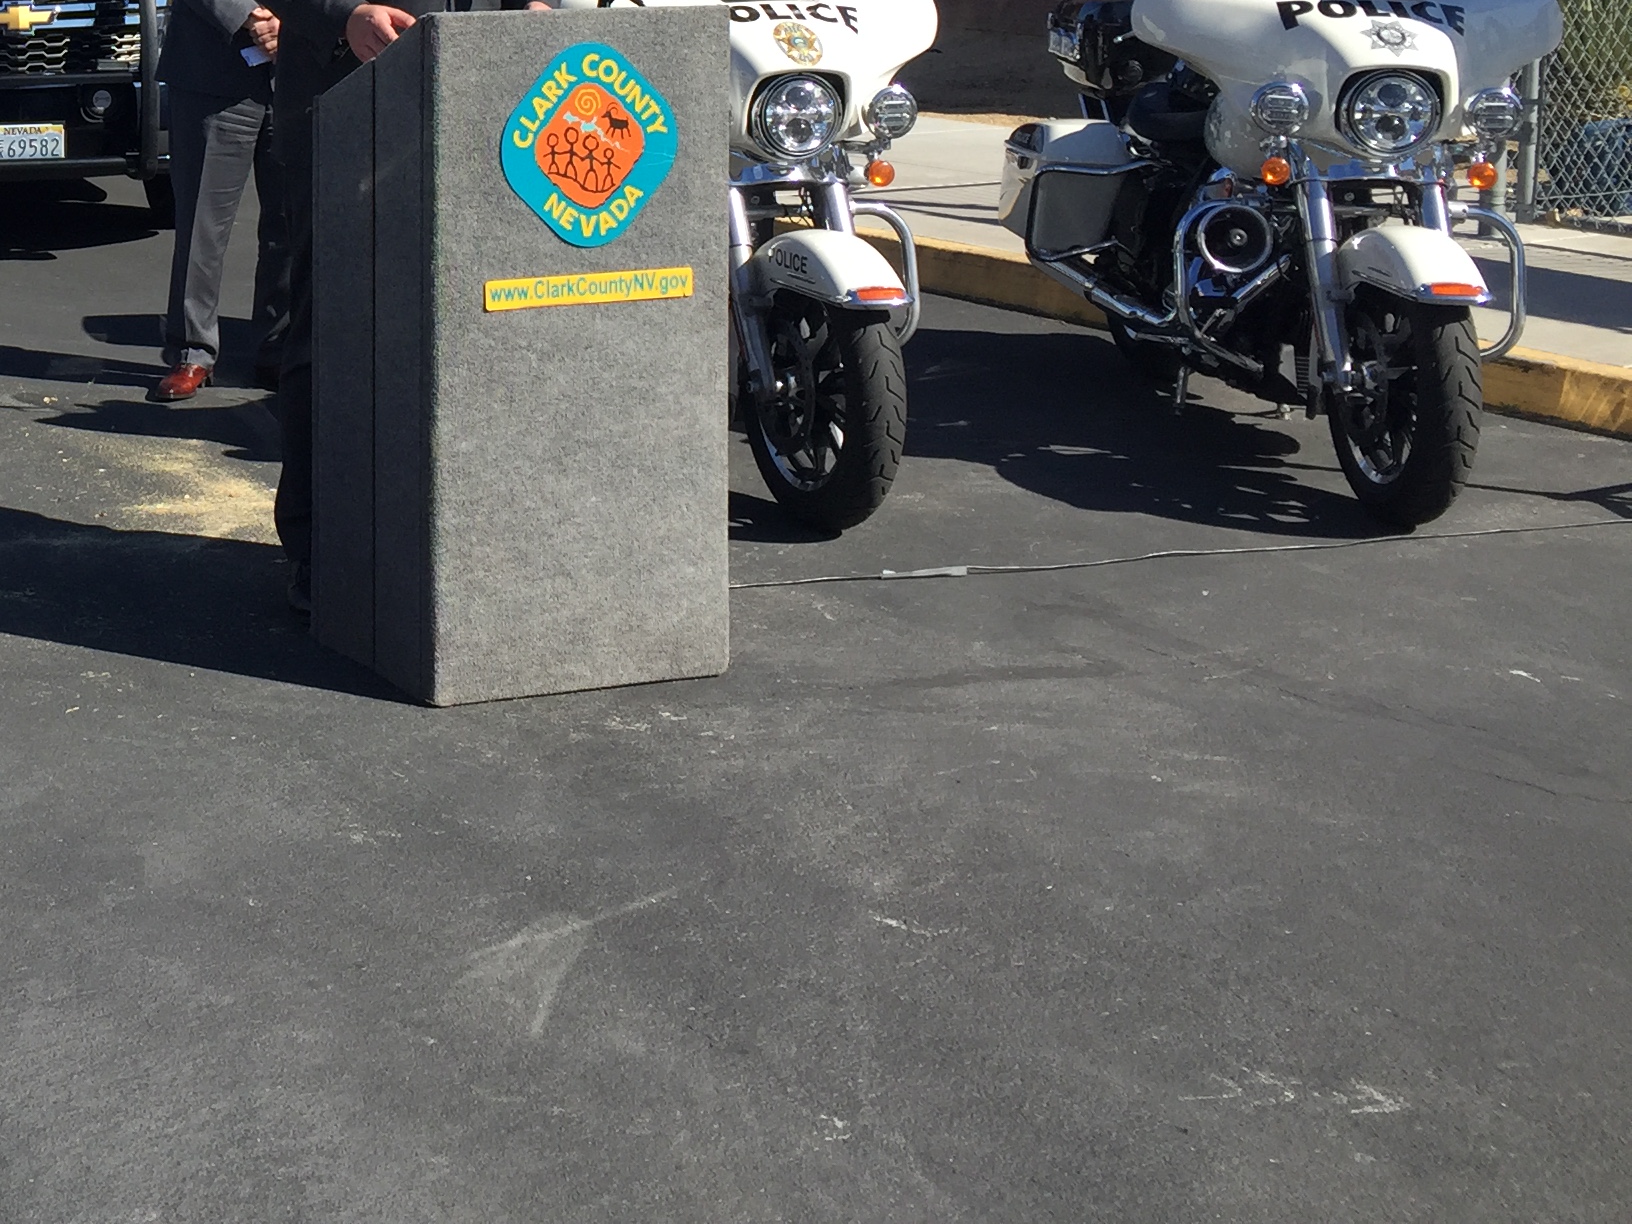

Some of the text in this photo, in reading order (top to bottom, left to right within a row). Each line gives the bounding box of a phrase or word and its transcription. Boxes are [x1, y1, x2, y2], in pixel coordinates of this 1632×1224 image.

[729, 2, 858, 35] OLICE
[1276, 0, 1466, 37] POLICE
[512, 53, 668, 149] CLARK COUNTY
[3, 126, 42, 136] NEVADA
[7, 137, 60, 158] 69582
[543, 184, 644, 237] NEVADA
[489, 272, 689, 302] www.ClarkCountyNV.gov
